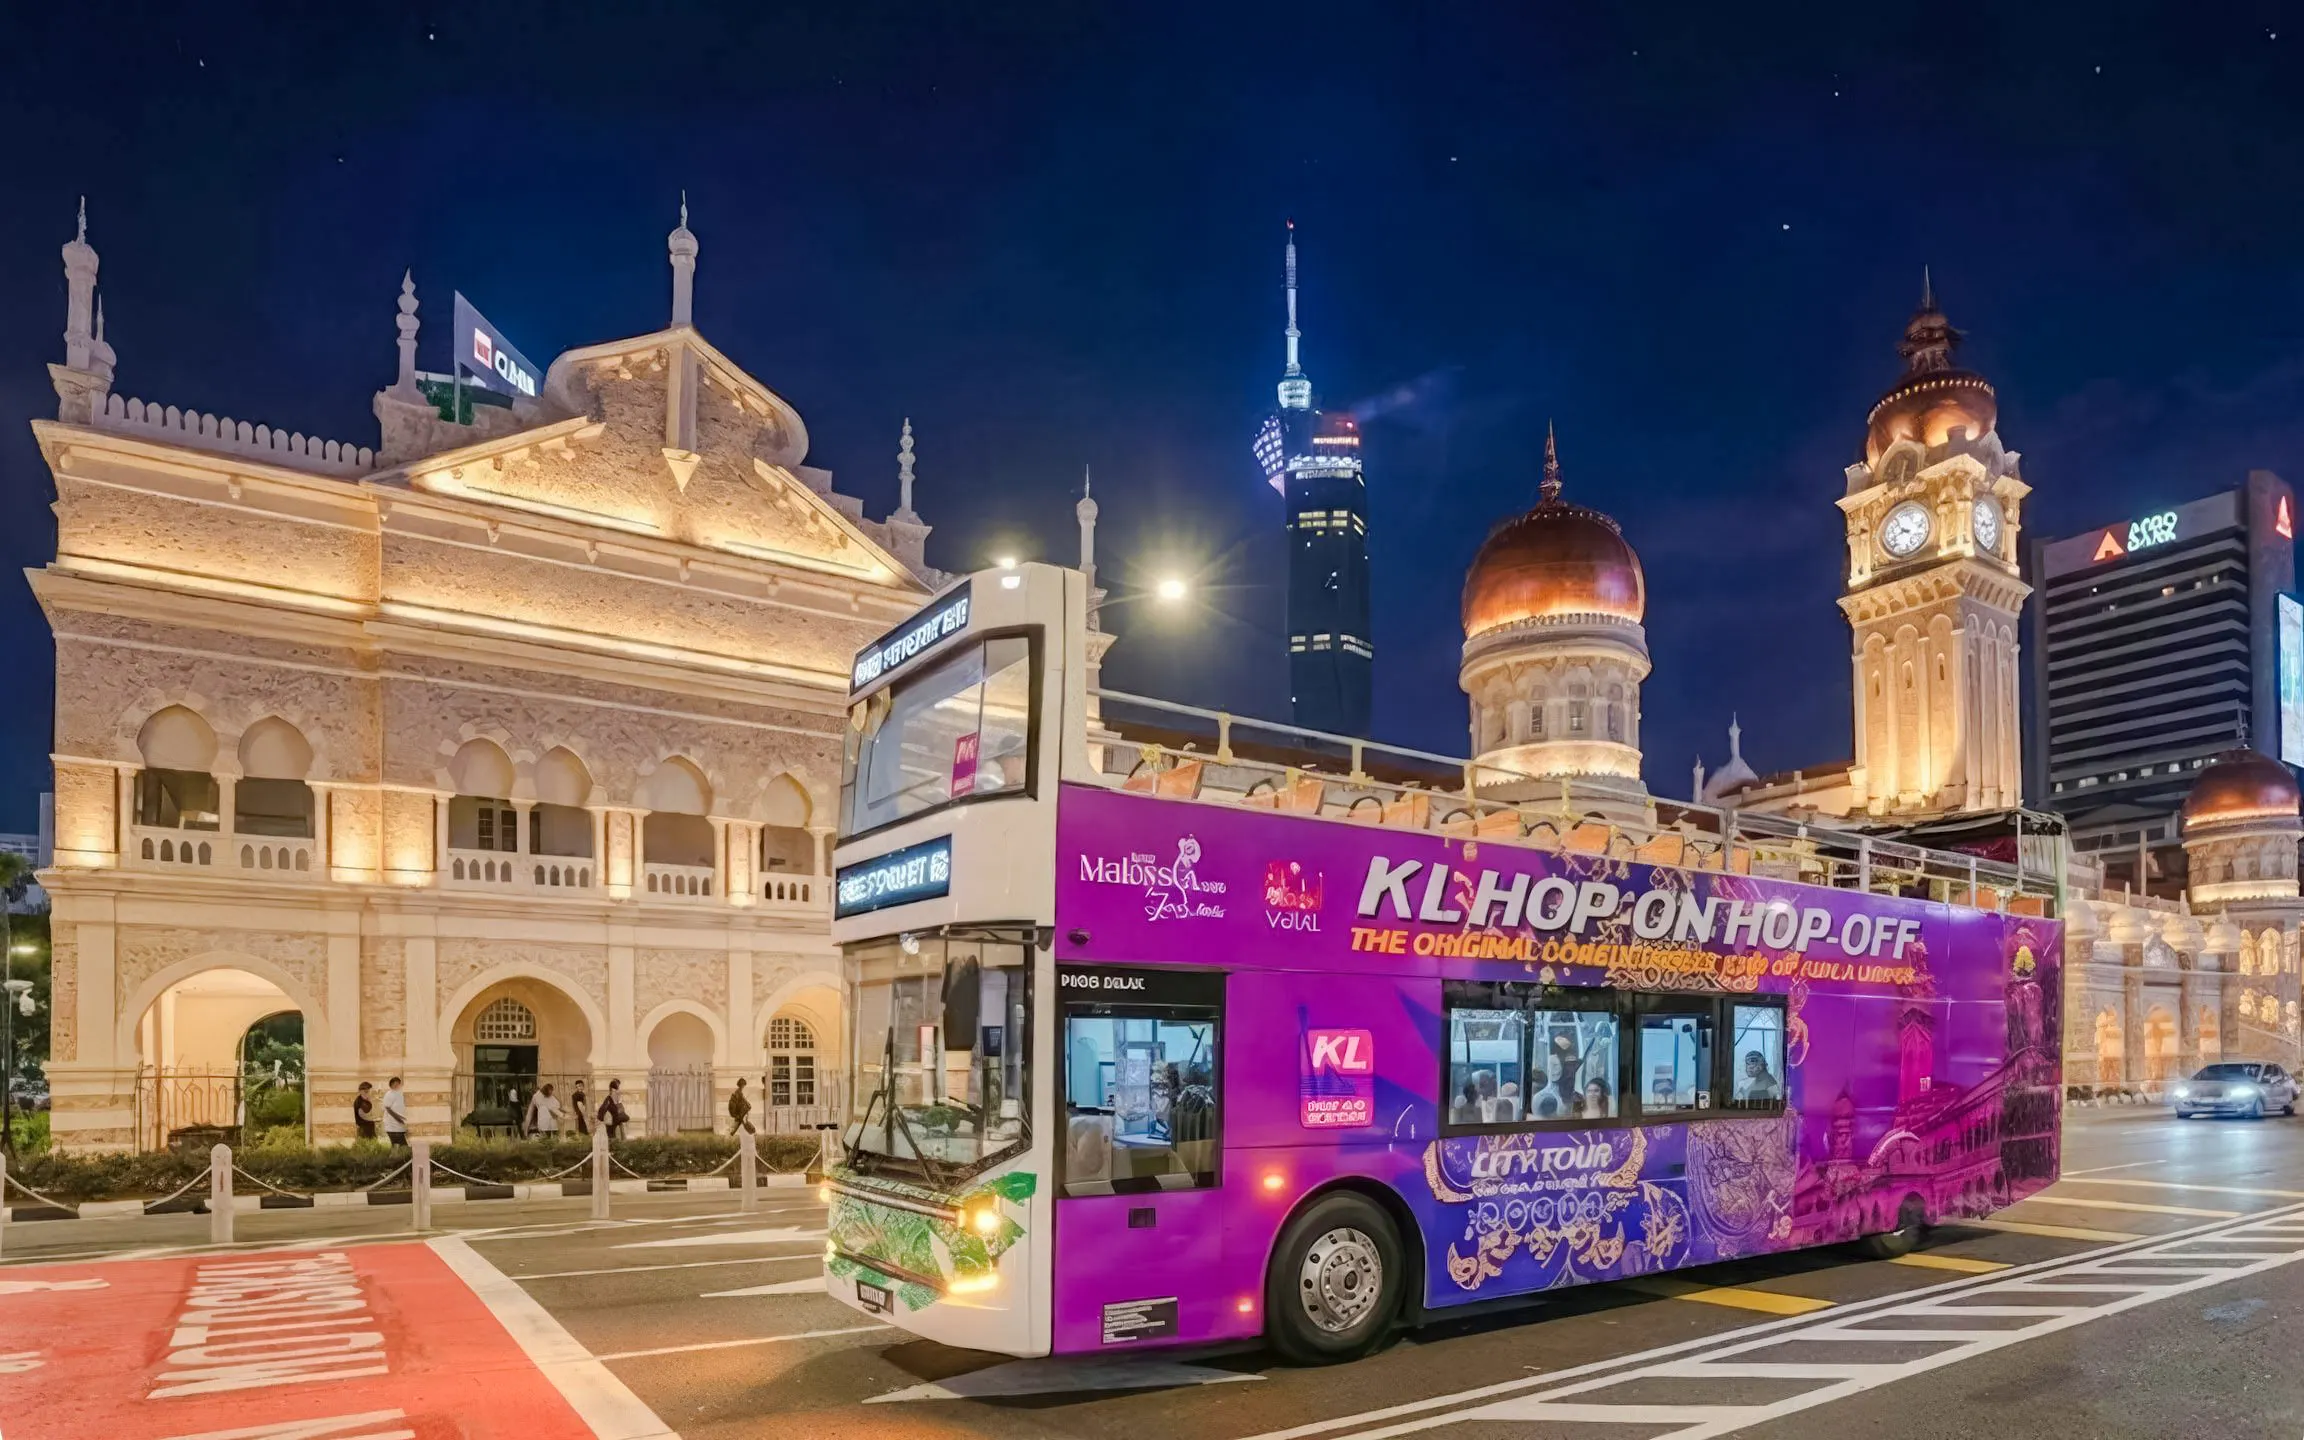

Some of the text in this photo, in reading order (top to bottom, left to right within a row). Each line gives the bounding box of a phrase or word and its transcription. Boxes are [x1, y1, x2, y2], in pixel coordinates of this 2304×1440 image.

[1357, 856, 1462, 923] KL
[1464, 869, 1720, 944] HOP-ON
[1722, 896, 1921, 959] HOP-OFF
[1350, 927, 1409, 955] THE
[1312, 1035, 1367, 1070] KL
[1540, 1142, 1613, 1171] TOUR
